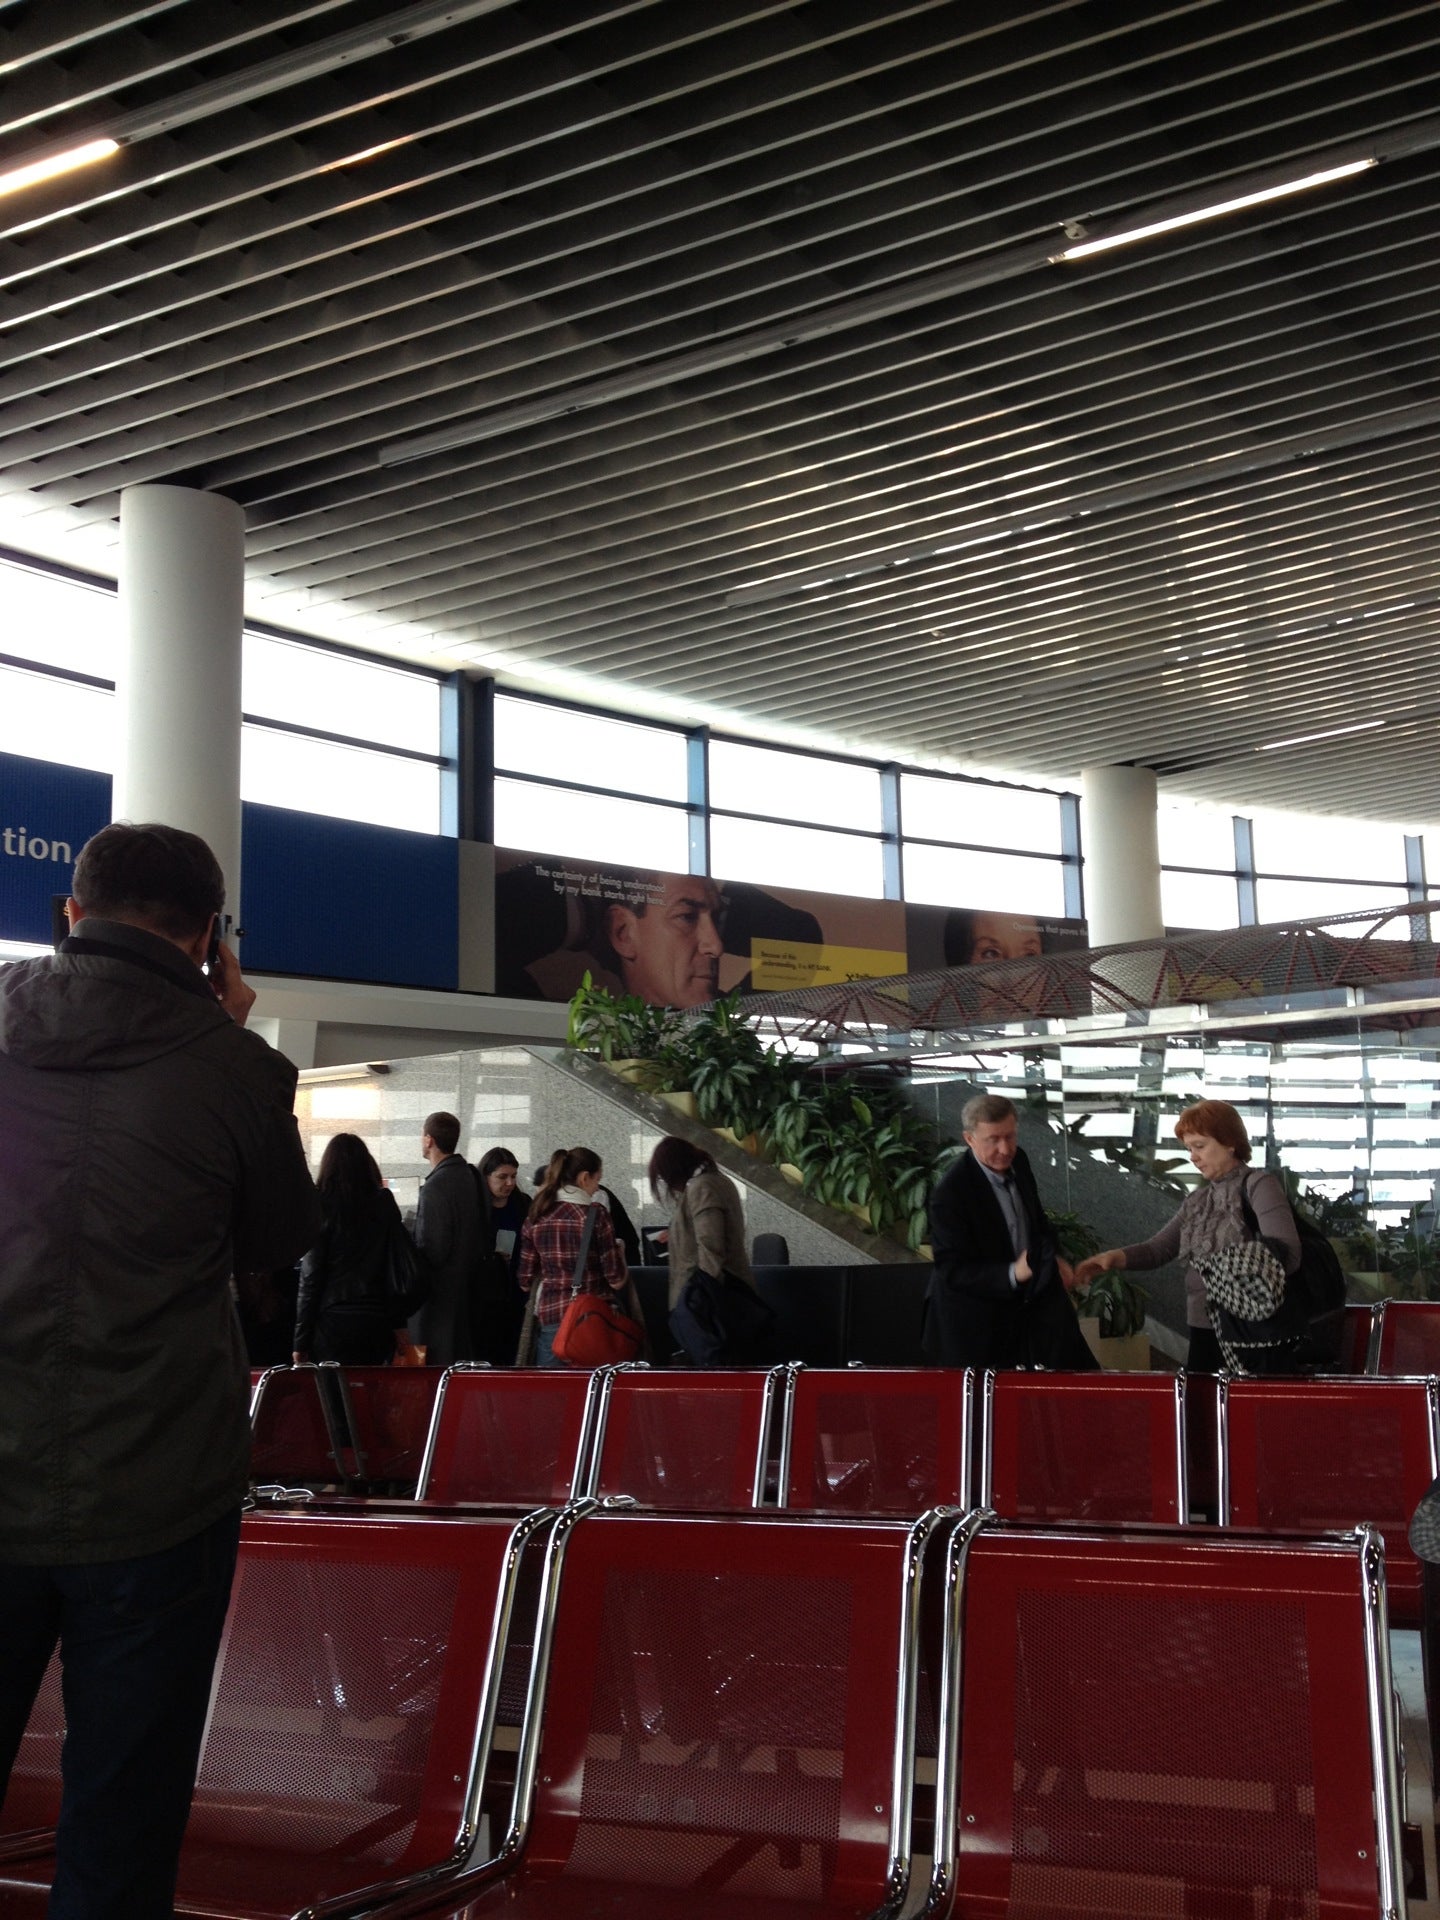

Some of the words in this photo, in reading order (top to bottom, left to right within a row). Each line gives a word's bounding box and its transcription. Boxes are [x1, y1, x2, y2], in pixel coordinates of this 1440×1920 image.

[535, 865, 550, 877] The
[552, 871, 587, 885] certainty
[588, 873, 598, 883] of
[599, 874, 622, 890] being
[623, 879, 665, 893] understood
[553, 880, 565, 895] by
[566, 886, 580, 896] my
[581, 884, 602, 897] bank
[604, 890, 625, 900] starts
[626, 891, 645, 905] right
[646, 893, 667, 905] here.
[1045, 924, 1059, 934] that
